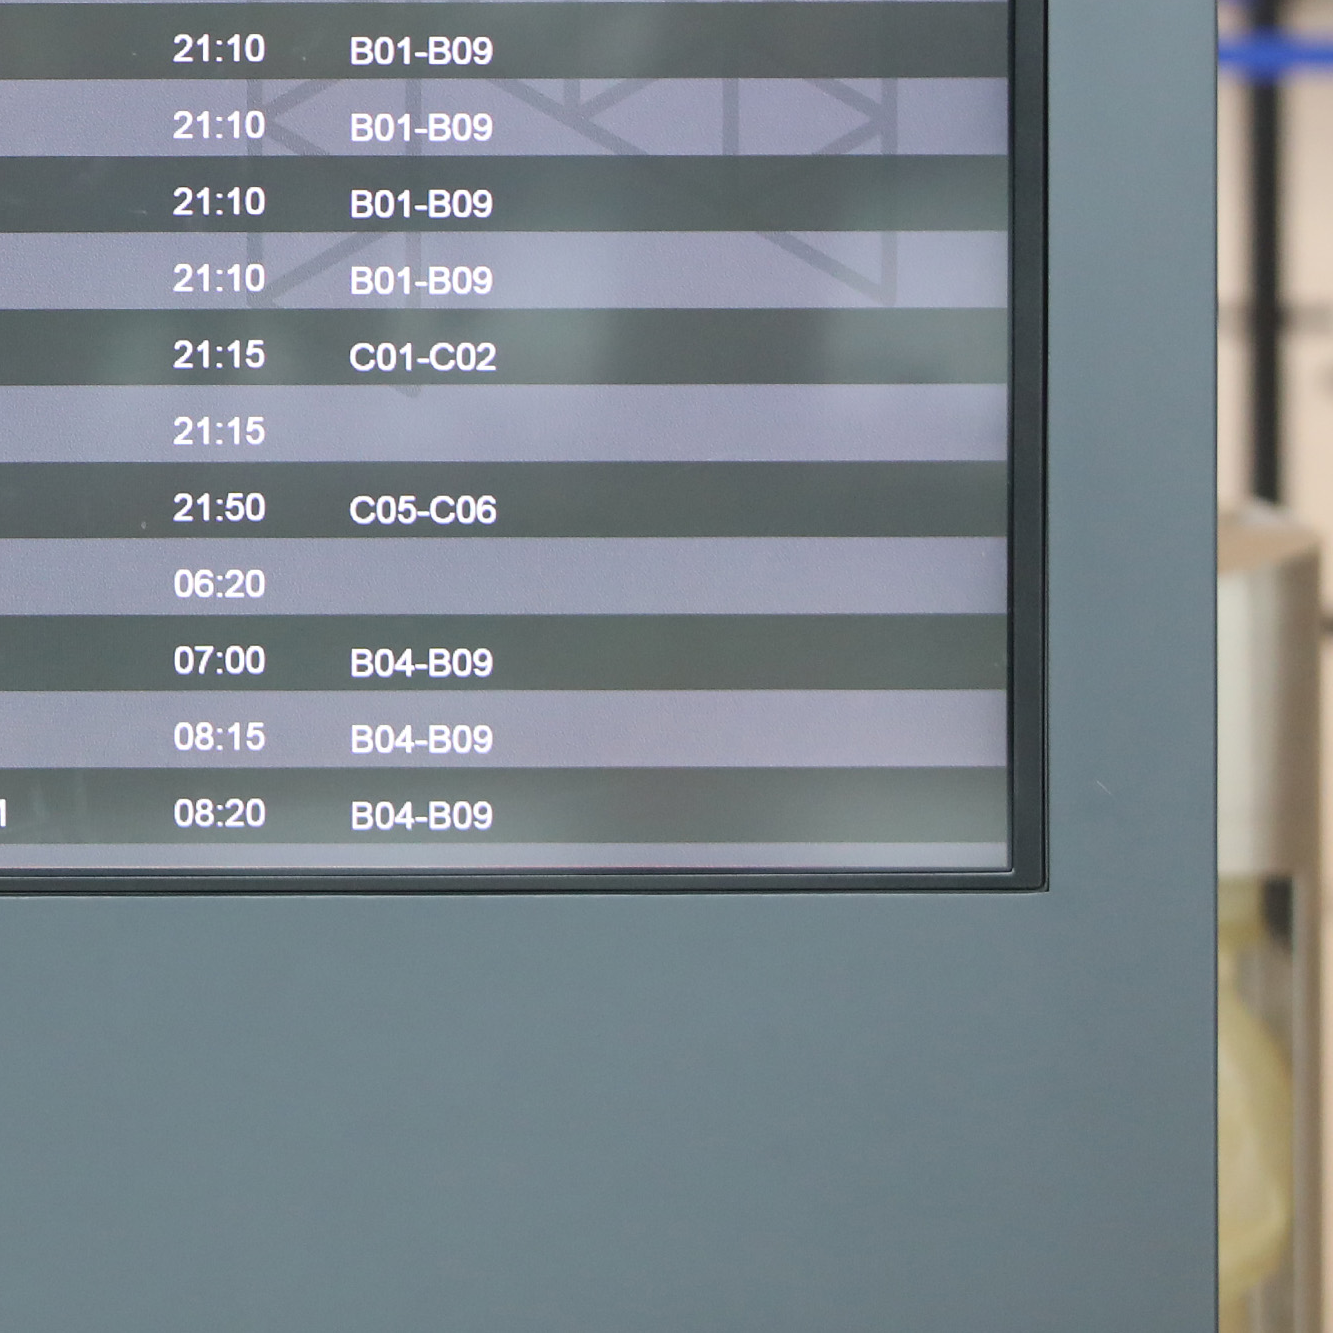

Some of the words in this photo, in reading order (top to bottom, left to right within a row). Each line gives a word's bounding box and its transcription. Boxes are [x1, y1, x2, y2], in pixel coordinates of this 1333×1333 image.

[173, 110, 265, 139] 21:10
[351, 112, 493, 142] B01-B09
[172, 186, 266, 216] 21:10
[351, 189, 493, 218] B01-B09
[173, 339, 265, 369] 21:15
[349, 342, 497, 371] C01-C02
[173, 416, 266, 445] 21:15
[173, 492, 266, 522] 21:50
[349, 495, 497, 525] C05-C06
[174, 568, 266, 598] 06:20
[174, 645, 266, 675] 07:00
[351, 647, 493, 678] B04-B09
[174, 721, 265, 751] 08:15
[351, 724, 493, 754] B04-B09
[174, 798, 266, 827] 08:20
[351, 800, 493, 830] B04-B09
